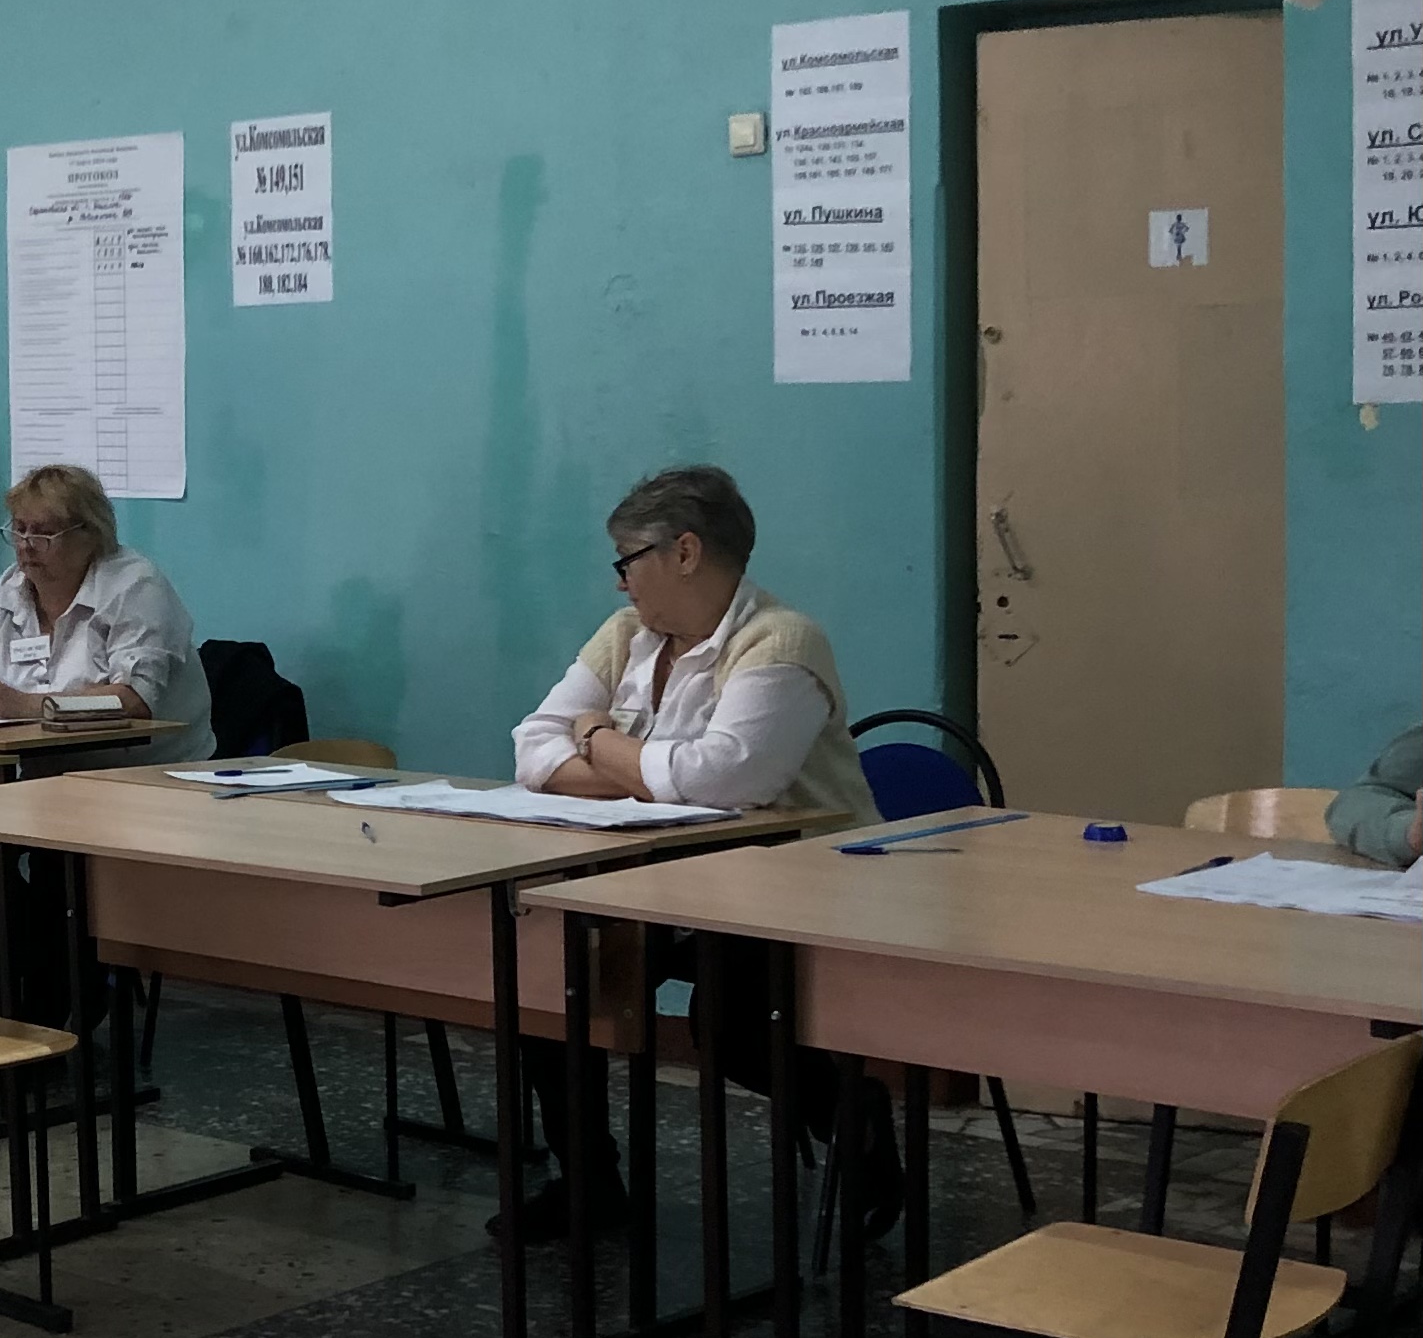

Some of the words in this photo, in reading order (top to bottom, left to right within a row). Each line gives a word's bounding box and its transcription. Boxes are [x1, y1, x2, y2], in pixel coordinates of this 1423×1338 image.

[1367, 129, 1400, 149] ул.
[255, 167, 267, 193] №
[784, 210, 807, 224] ул.
[812, 206, 883, 223] Пушкина
[1367, 211, 1400, 230] ул.
[1367, 295, 1393, 309] ул.
